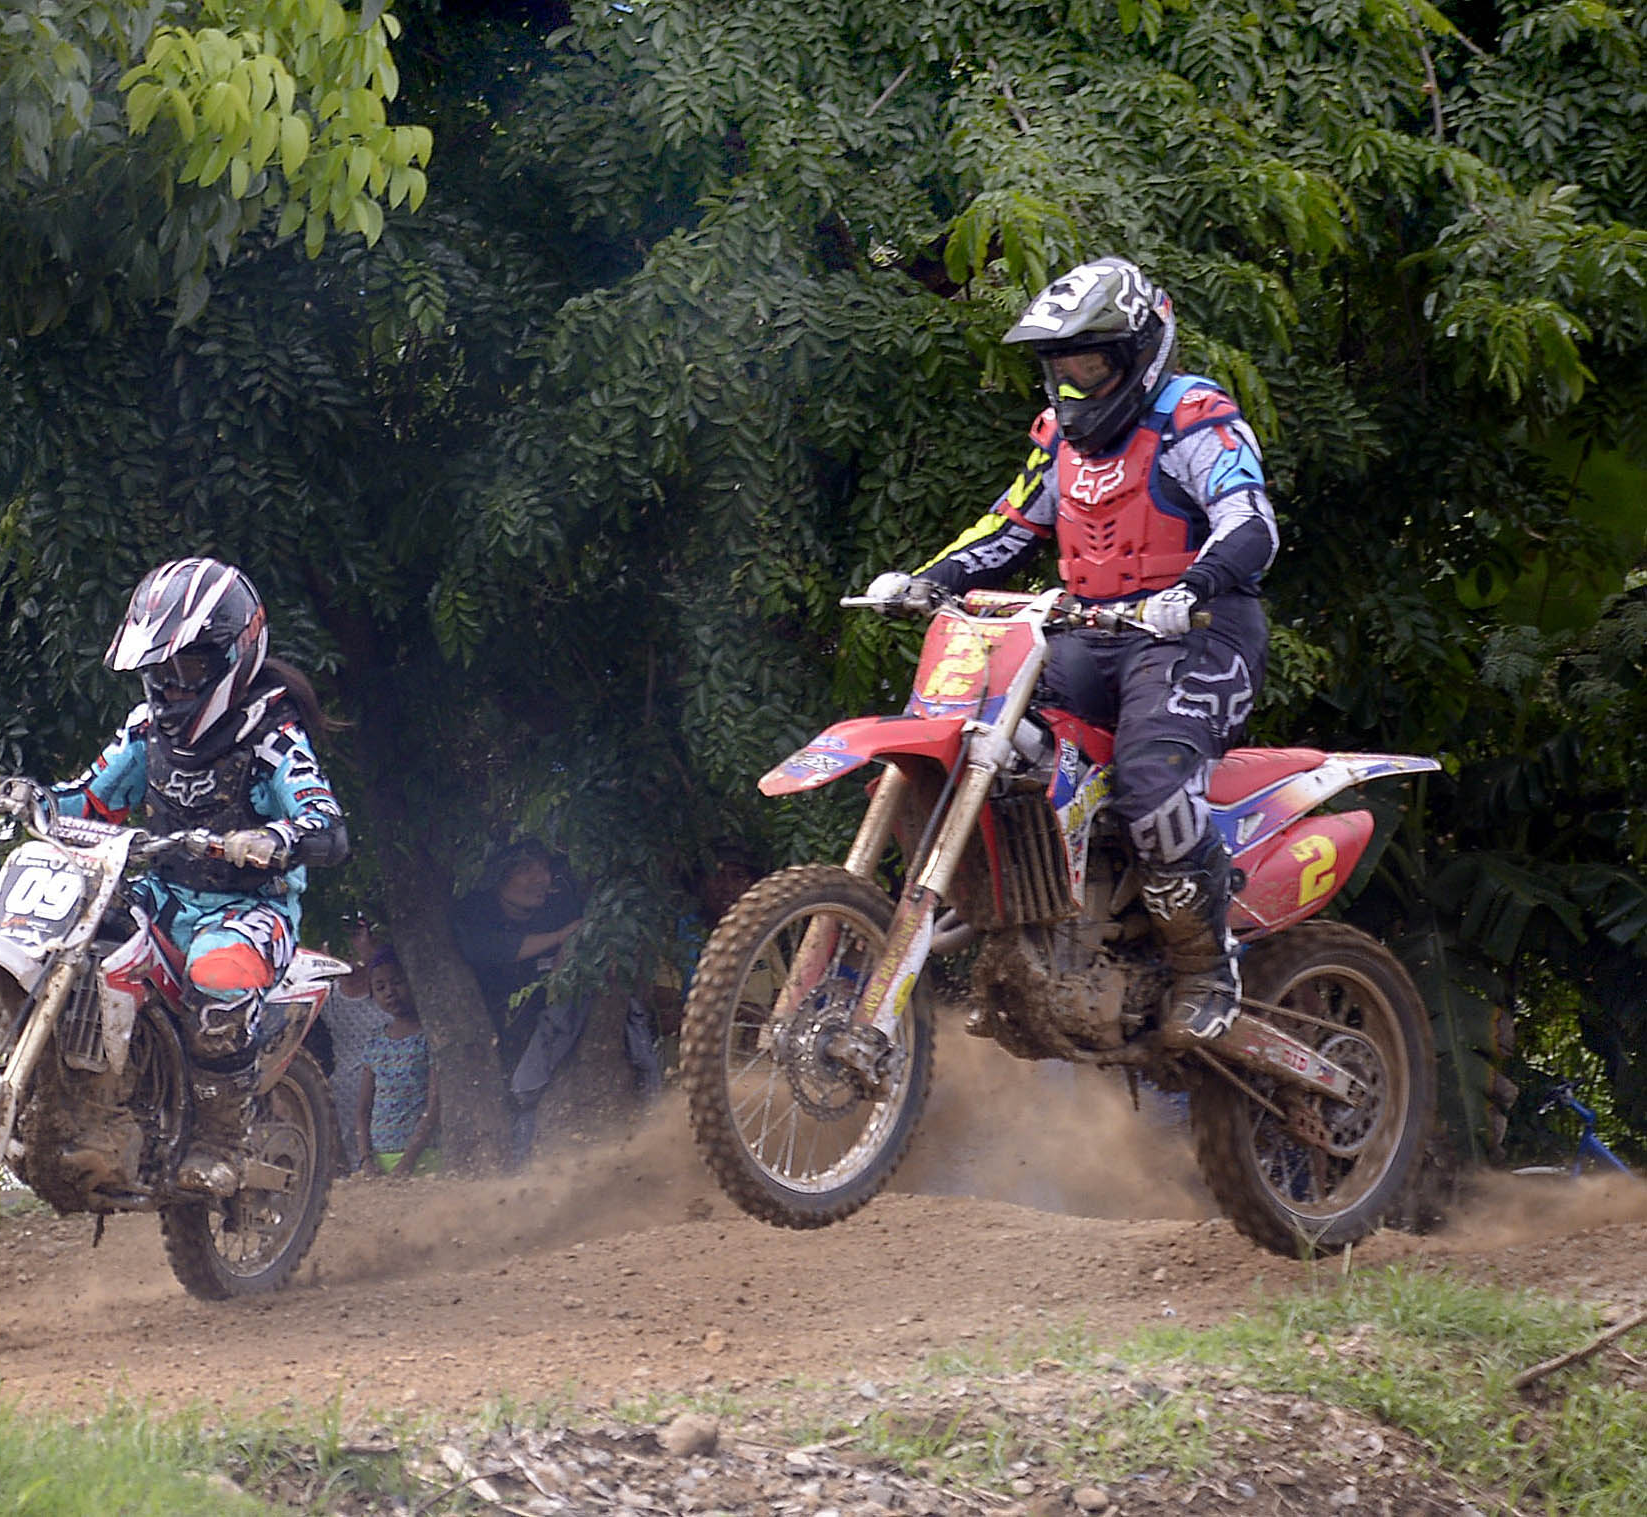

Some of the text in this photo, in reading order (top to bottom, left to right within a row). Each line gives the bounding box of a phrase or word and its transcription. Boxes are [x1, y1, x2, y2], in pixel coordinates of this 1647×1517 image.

[922, 633, 993, 698] 2
[4, 865, 83, 921] 09
[1290, 834, 1339, 907] 2
